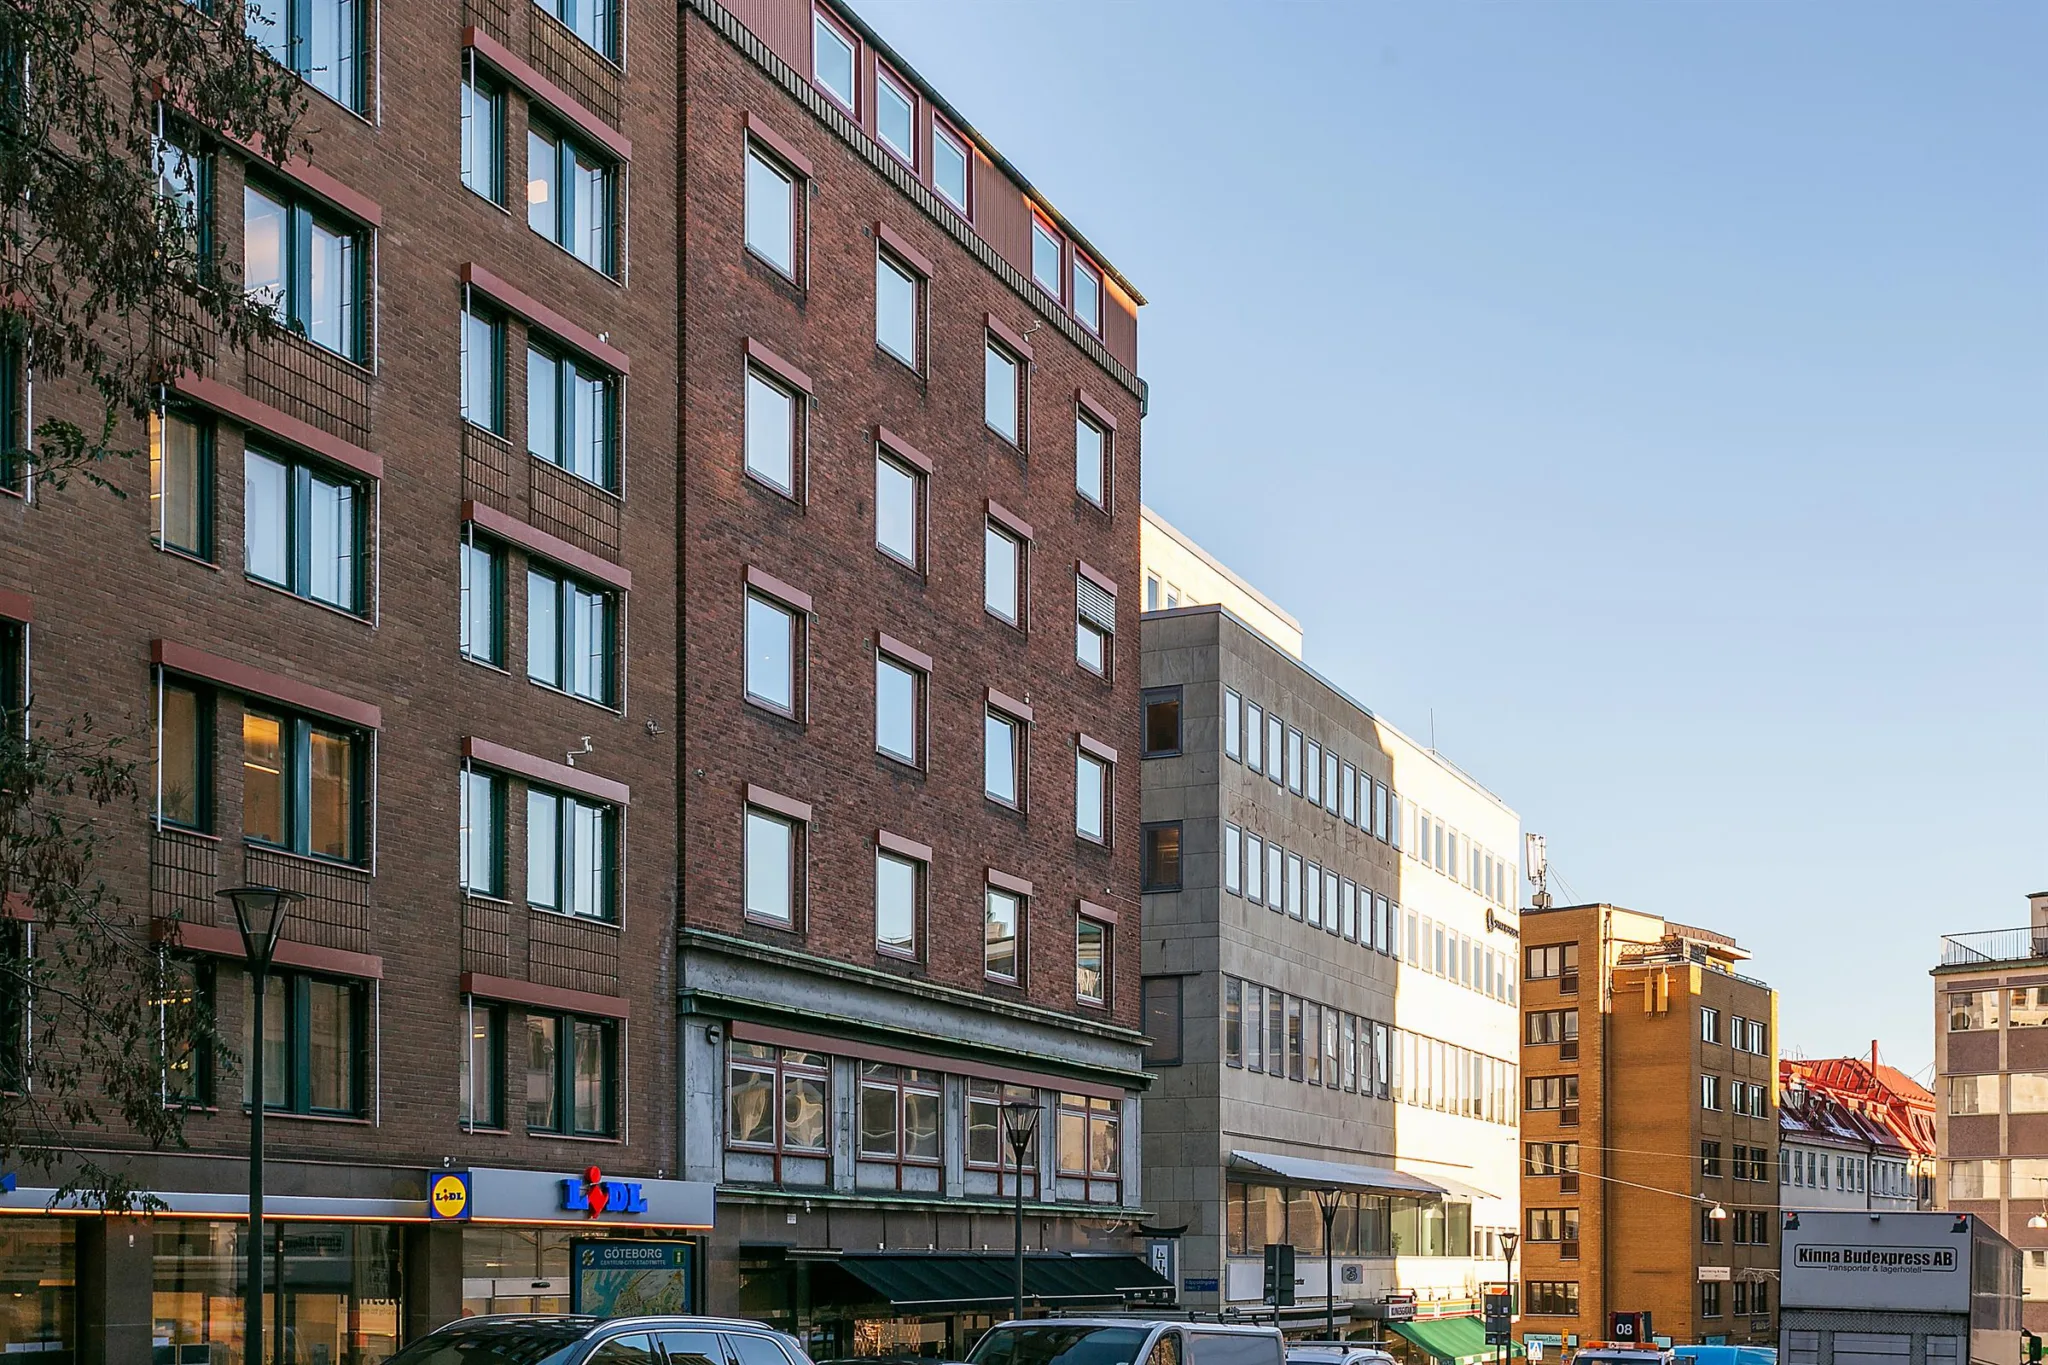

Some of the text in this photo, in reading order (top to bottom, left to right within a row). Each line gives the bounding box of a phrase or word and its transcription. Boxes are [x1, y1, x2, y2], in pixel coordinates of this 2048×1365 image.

[604, 1246, 662, 1259] GÖTEBORG
[1799, 1248, 1953, 1266] Kinna Budexpress AB
[1828, 1264, 1870, 1272] transporter
[1880, 1266, 1922, 1275] lagerhotell
[1616, 1323, 1633, 1336] 08
